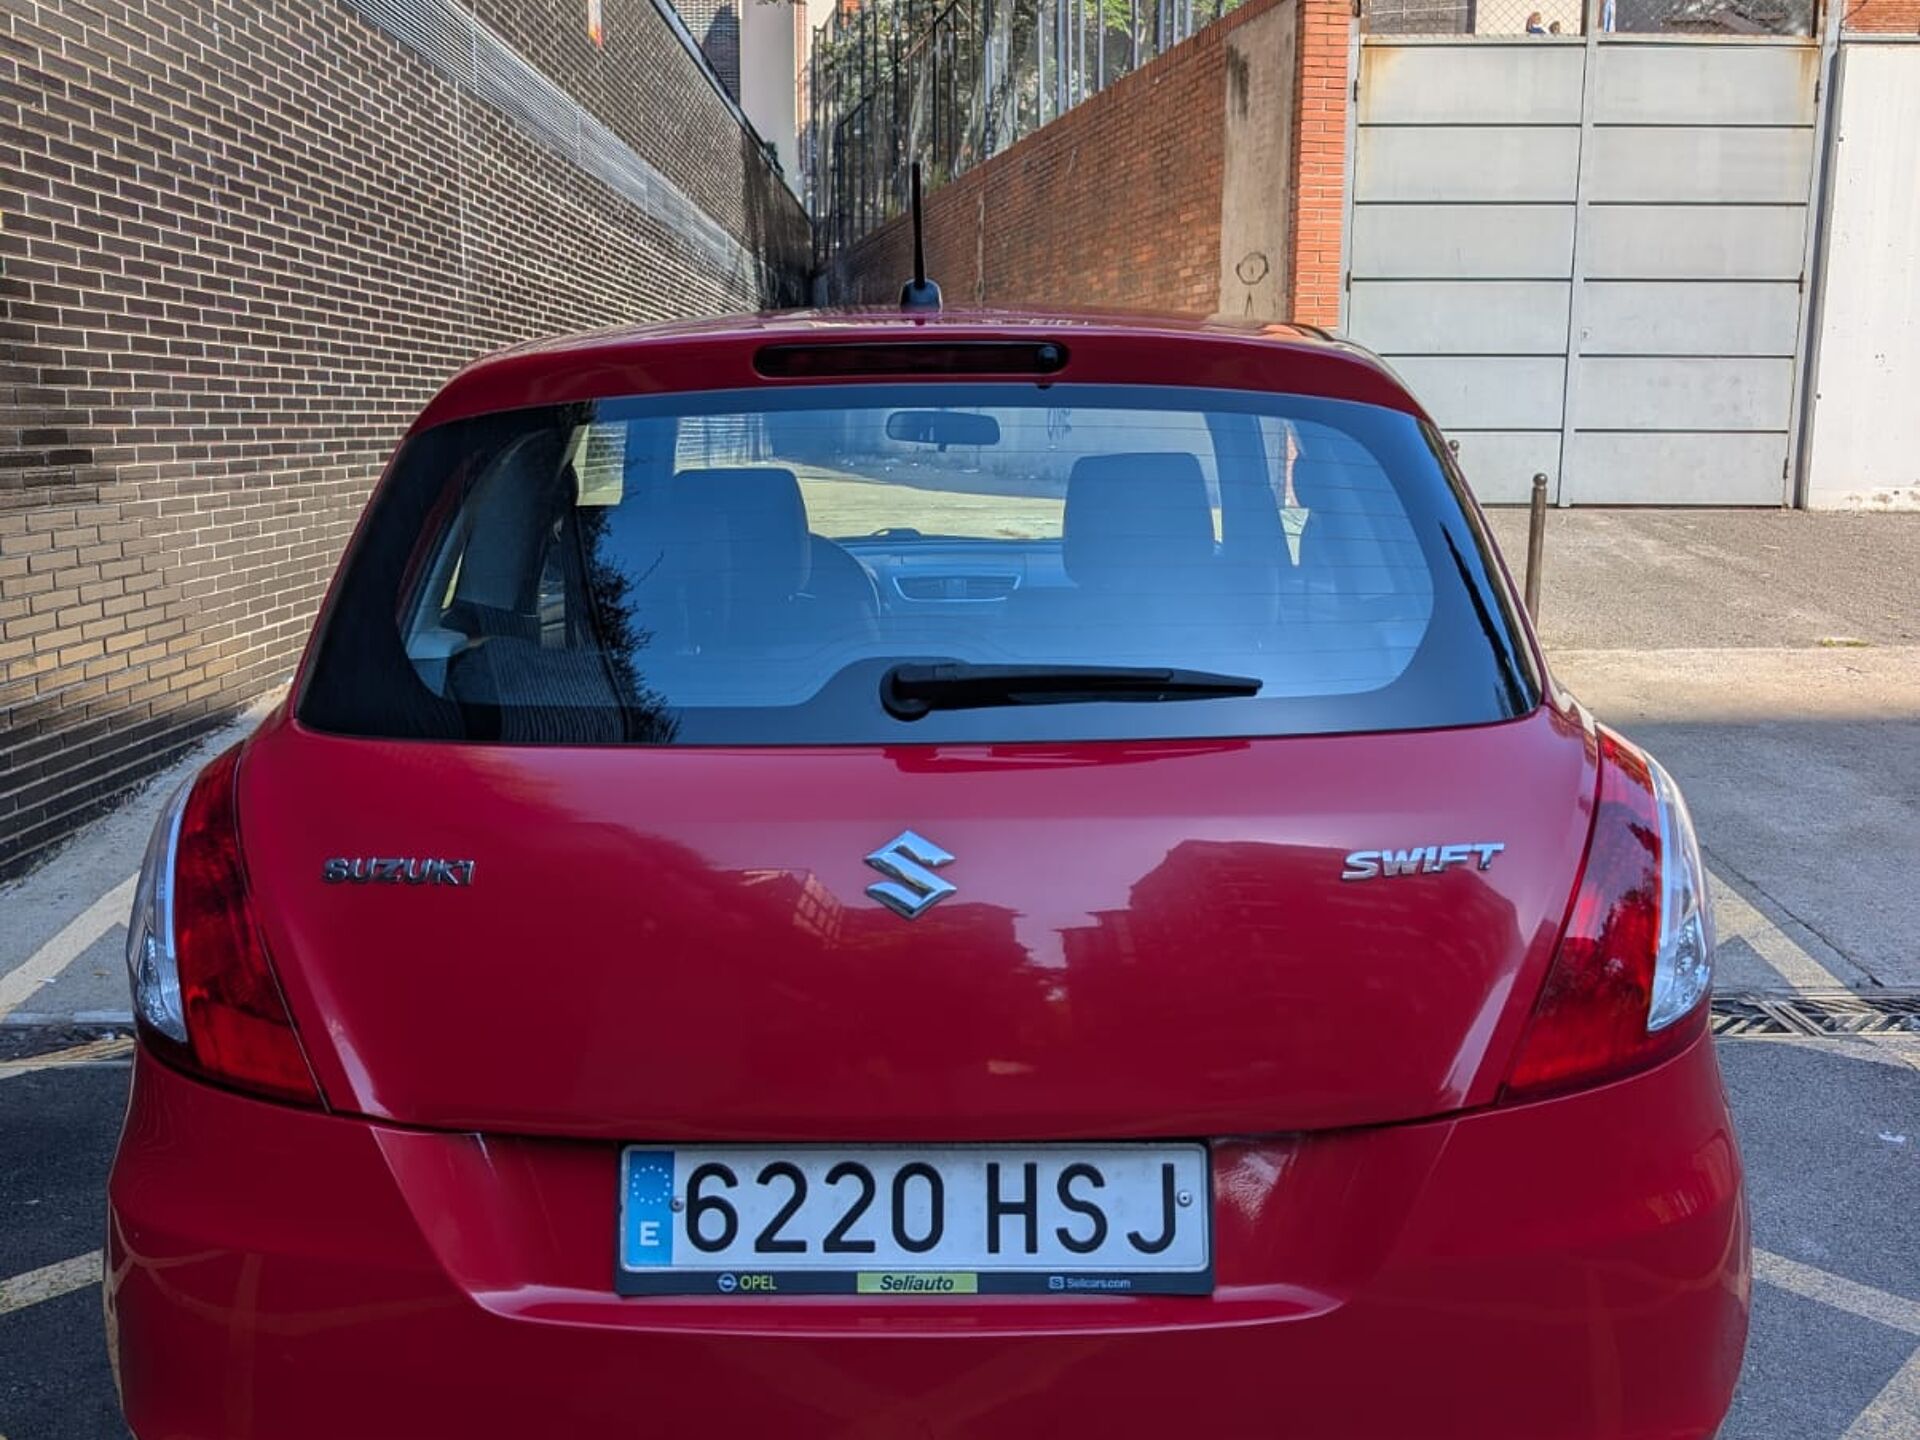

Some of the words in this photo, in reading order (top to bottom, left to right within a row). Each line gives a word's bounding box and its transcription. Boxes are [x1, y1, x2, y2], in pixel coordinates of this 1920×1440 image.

[322, 857, 475, 885] SUZUKI
[1341, 842, 1505, 880] SWIFT
[685, 1161, 945, 1254] 6220
[985, 1162, 1177, 1254] HSJ
[639, 1221, 660, 1246] E
[740, 1275, 777, 1290] OPEL
[879, 1274, 955, 1292] Seliauto
